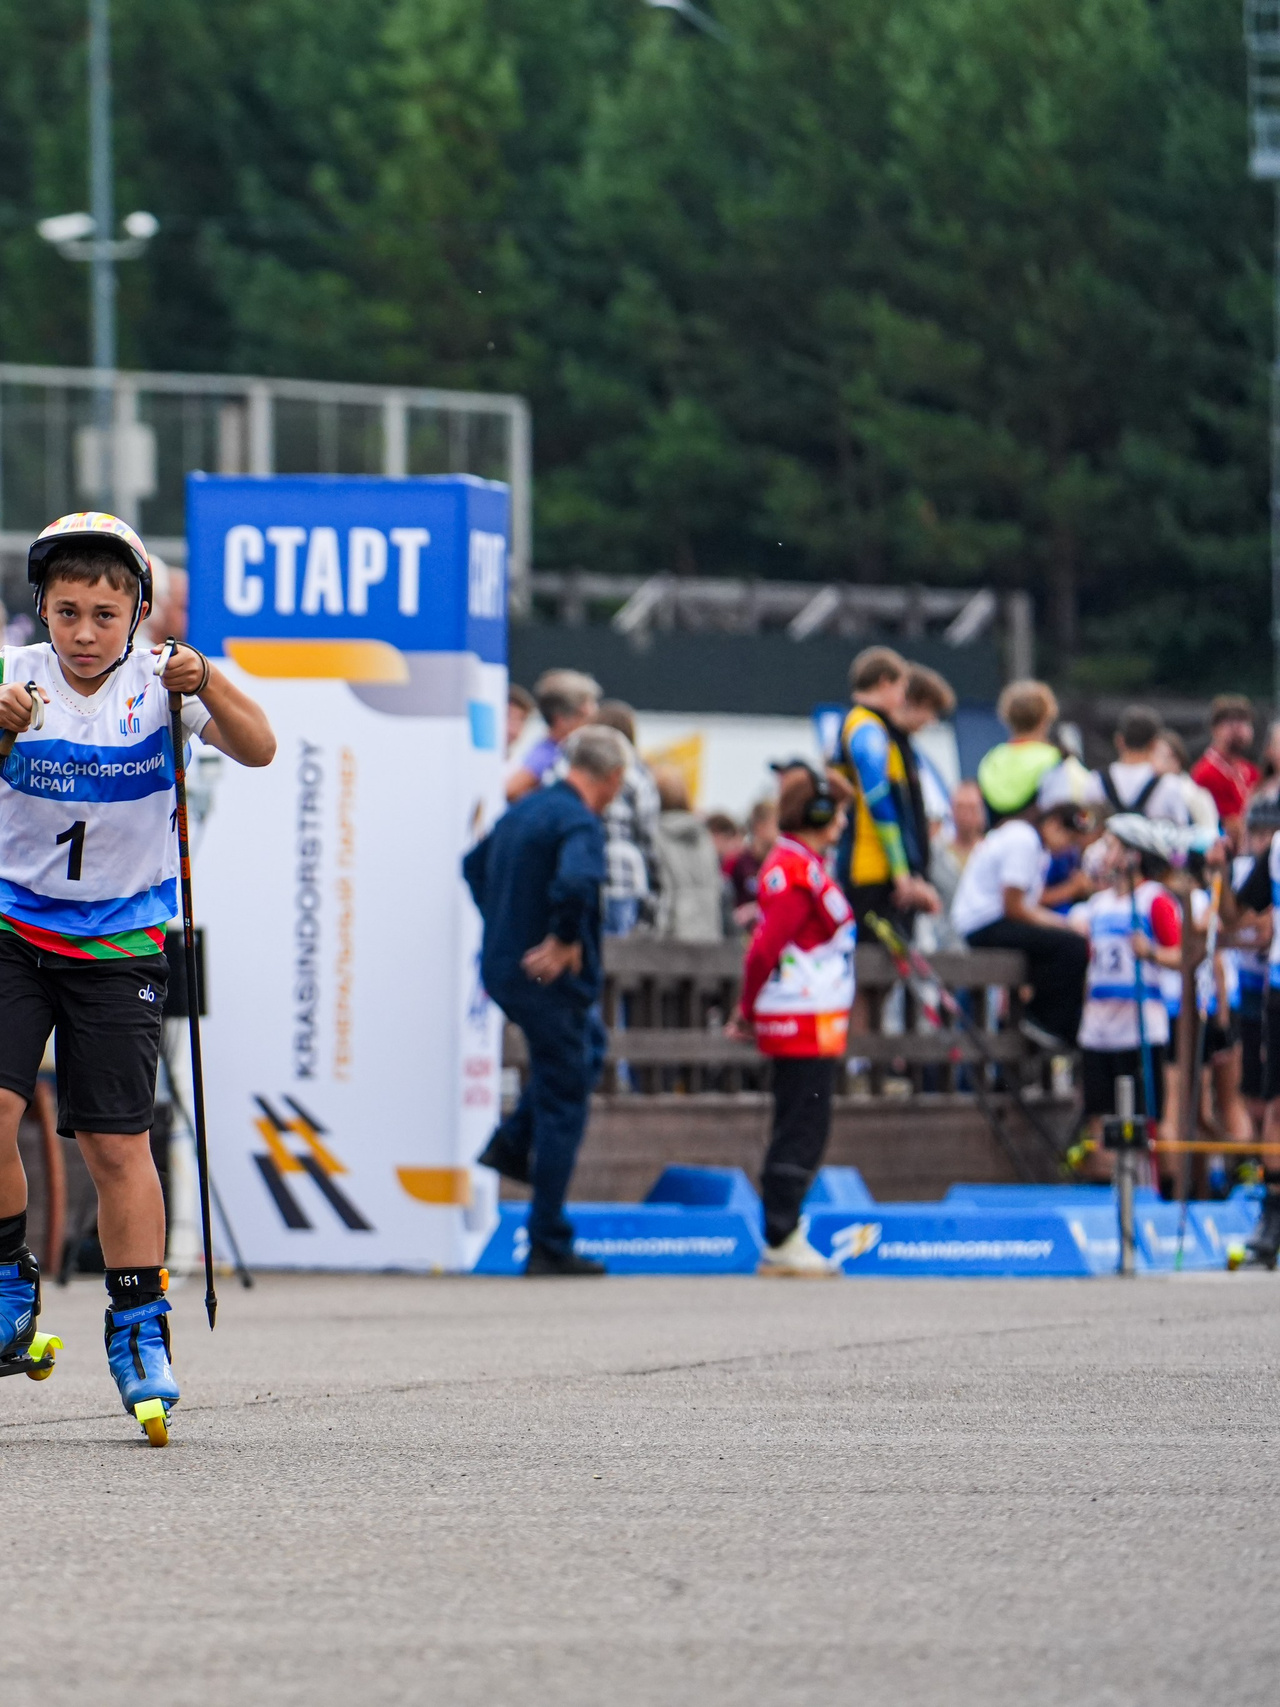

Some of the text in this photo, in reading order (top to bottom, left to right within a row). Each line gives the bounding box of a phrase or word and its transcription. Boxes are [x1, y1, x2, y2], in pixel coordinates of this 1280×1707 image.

[223, 524, 431, 617] СТАРТ
[30, 752, 166, 778] КРАСНОЯРСКИЙ
[30, 774, 75, 793] КРАЙ
[56, 821, 86, 881] 1
[293, 738, 324, 1082] KRASINDORSTROY
[118, 1274, 139, 1287] 151
[123, 1305, 159, 1321] SPINE
